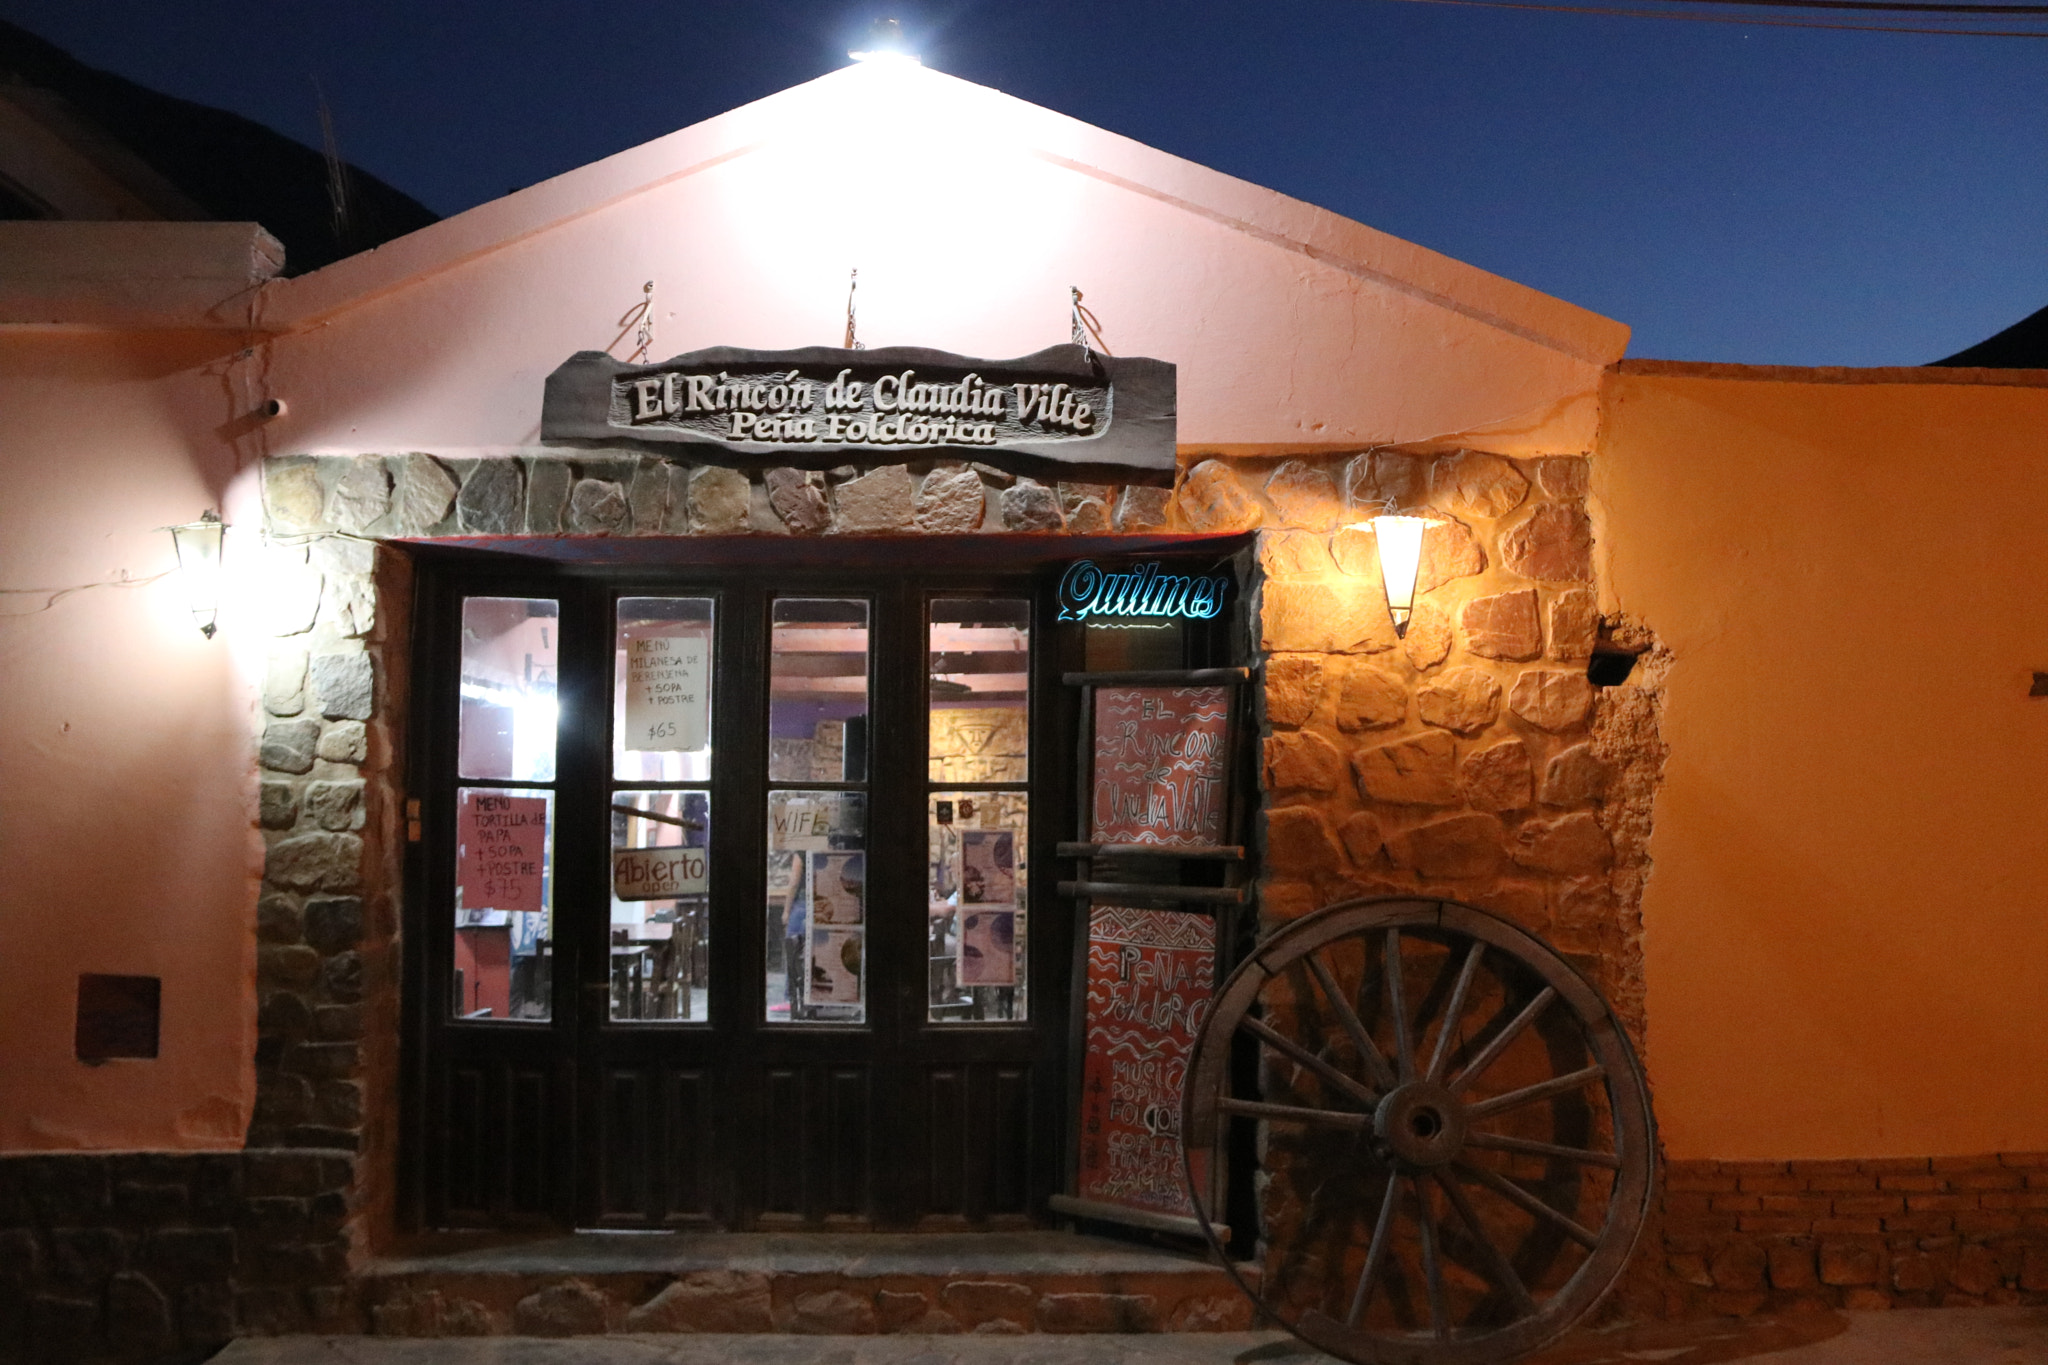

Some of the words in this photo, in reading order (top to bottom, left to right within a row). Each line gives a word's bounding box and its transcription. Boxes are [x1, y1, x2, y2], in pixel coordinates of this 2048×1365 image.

[635, 372, 681, 421] El
[684, 370, 815, 412] Rincón
[825, 368, 865, 410] de
[873, 369, 1006, 416] Claudia
[1012, 383, 1092, 430] Vilte
[728, 411, 817, 440] Peña
[824, 412, 997, 444] Folclórica
[1057, 559, 1229, 621] Quilmes
[630, 656, 683, 669] MILANESA
[686, 655, 699, 665] DE
[631, 669, 689, 682] BERENJENA
[654, 683, 682, 693] SOPA
[657, 694, 695, 705] POSTRE
[1141, 698, 1175, 720] EL
[648, 721, 677, 740] $65
[1144, 756, 1172, 785] de
[473, 813, 528, 827] TORTILLA
[477, 828, 511, 843] PAPA
[488, 846, 523, 859] SOPA
[615, 853, 705, 886] Abierto
[484, 878, 522, 900] $75
[642, 880, 679, 895] open
